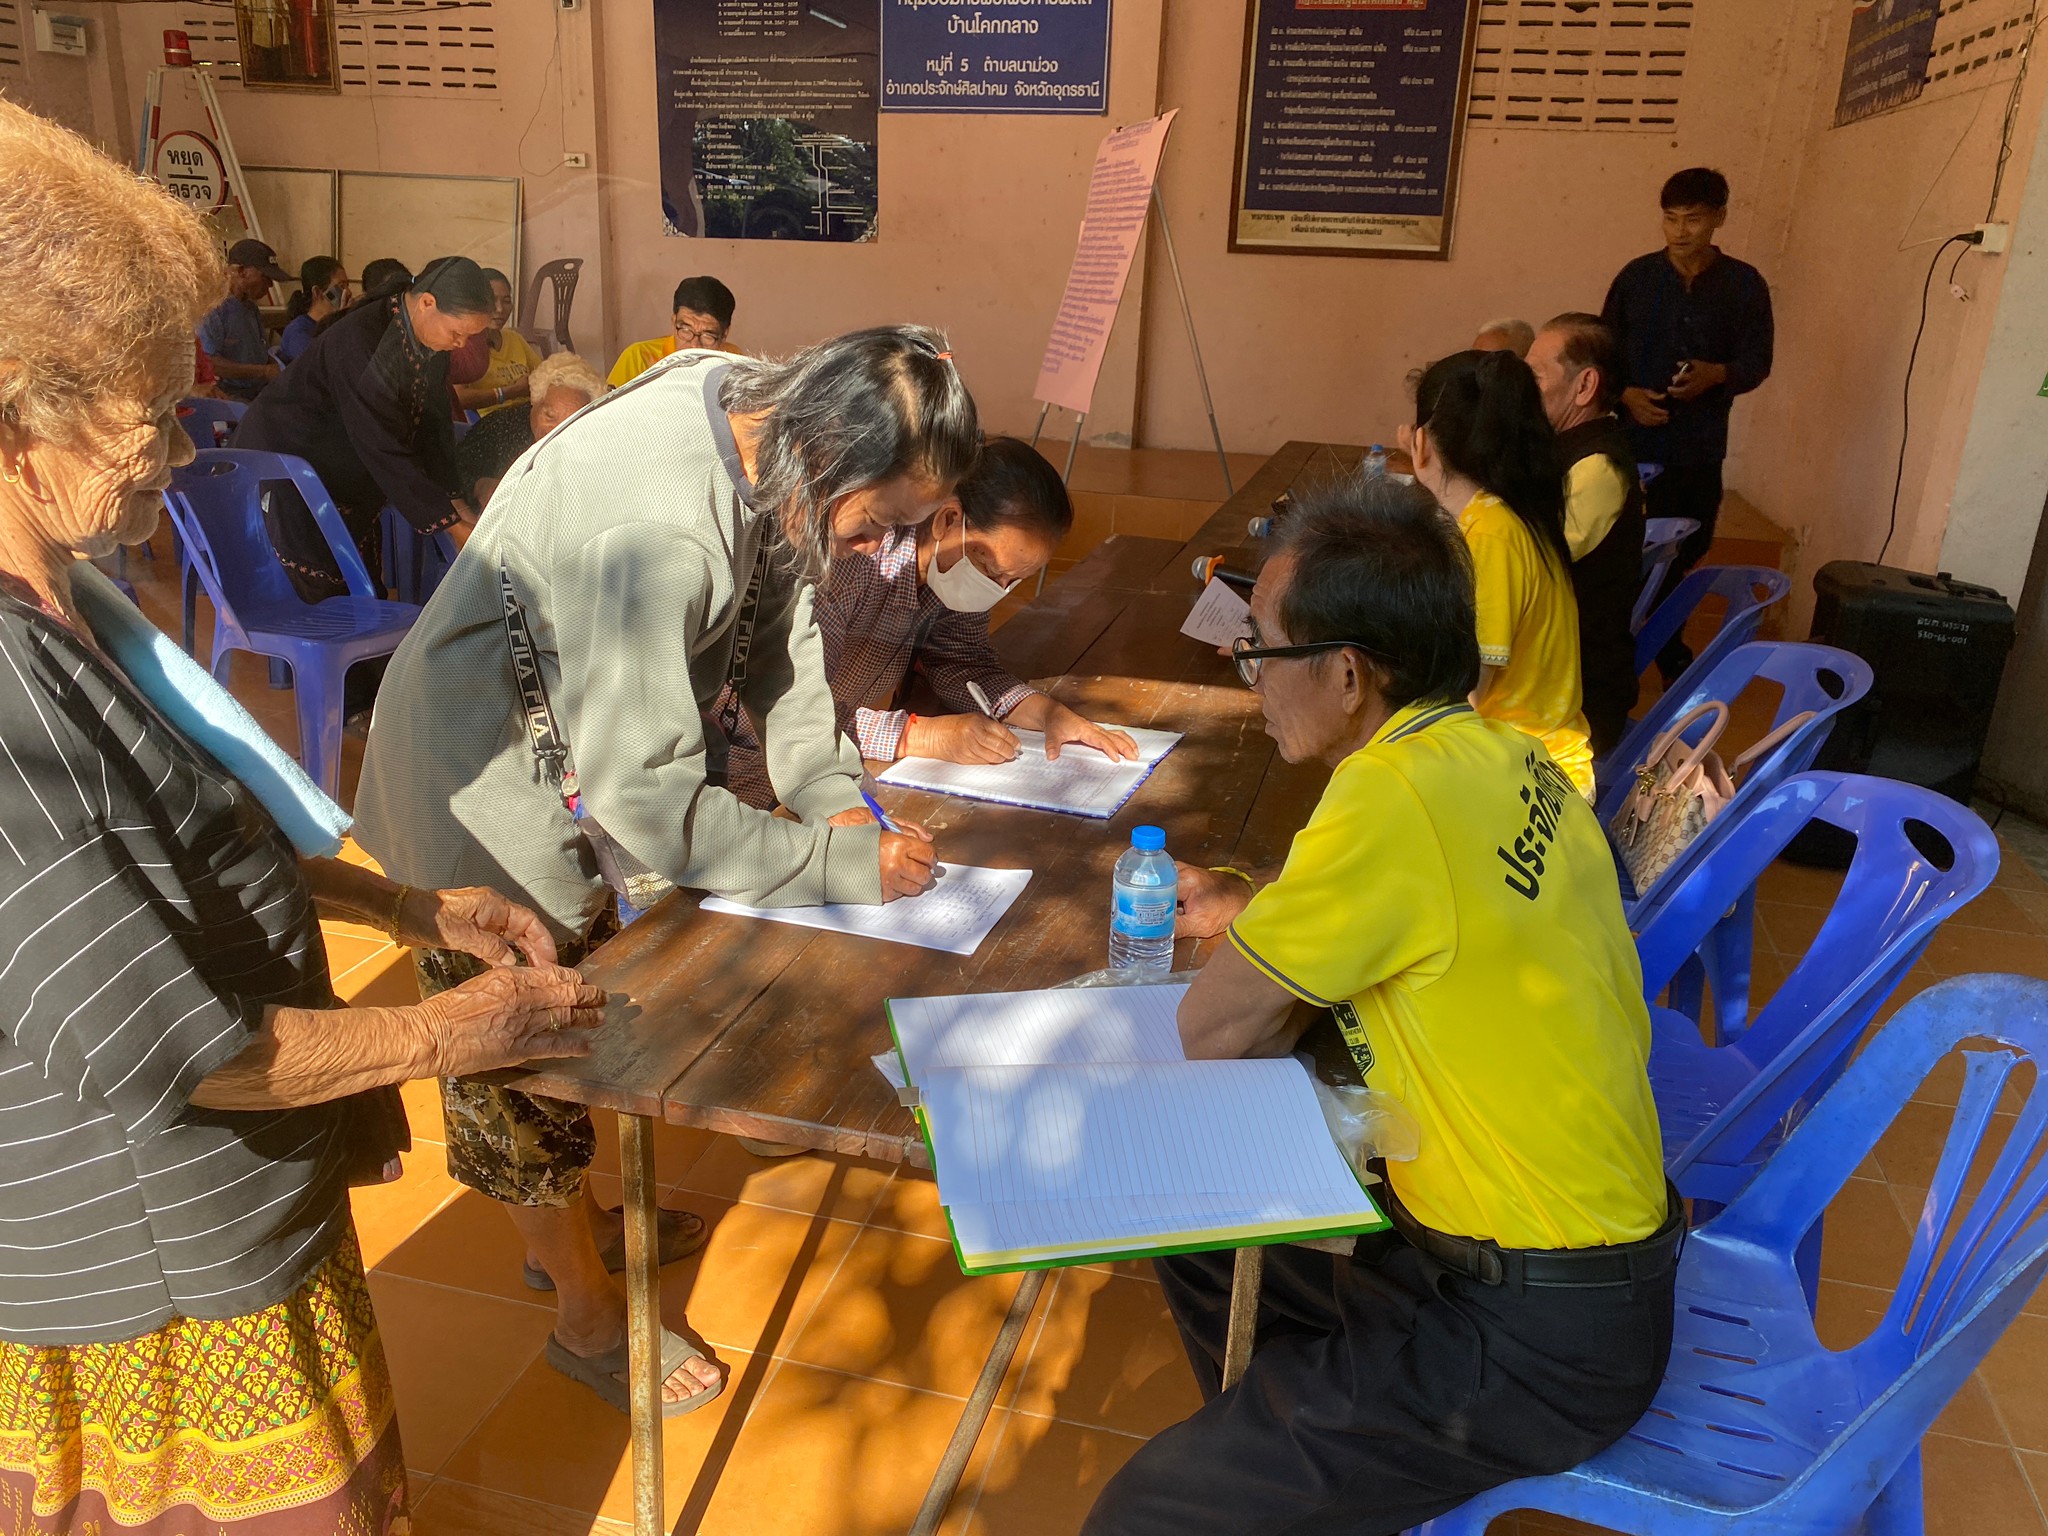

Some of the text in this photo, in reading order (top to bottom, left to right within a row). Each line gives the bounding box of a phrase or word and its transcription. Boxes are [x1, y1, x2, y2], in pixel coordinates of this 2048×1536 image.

[947, 12, 1039, 34] บ้านโคกกลาง
[926, 52, 1059, 76] หมู่ที่ 5 ตำบลนาม่วง
[886, 79, 1007, 96] อำเภอประจักษ์ศิลปาคม
[1014, 80, 1100, 101] จังหวัดอุดรธานี
[167, 150, 204, 174] หยุด
[168, 183, 212, 200] ตรวจ
[735, 620, 753, 664] FILA
[511, 629, 534, 680] FILA
[525, 690, 550, 739] FILA
